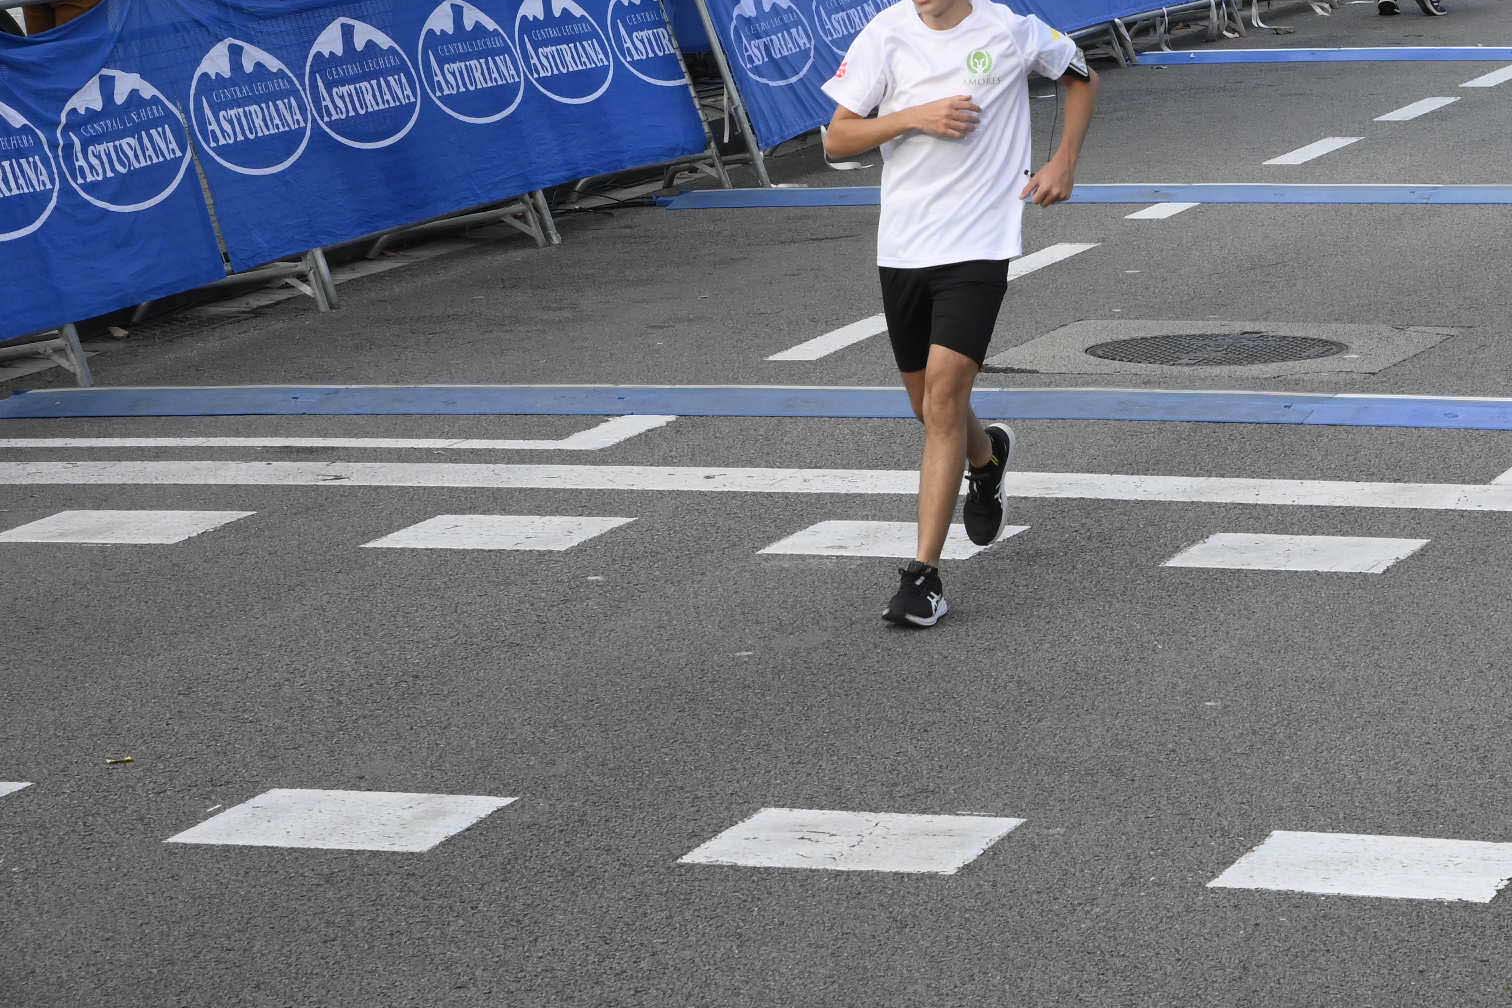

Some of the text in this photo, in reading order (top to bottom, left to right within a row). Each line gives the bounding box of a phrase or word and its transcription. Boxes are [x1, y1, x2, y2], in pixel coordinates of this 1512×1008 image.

[439, 36, 505, 56] CENTRAL LECHERA
[532, 23, 592, 41] CENTRAL LECHERA
[617, 19, 678, 61] ASTUR
[326, 54, 401, 80] CENTRAL LECHERA
[428, 49, 520, 97] ASTURIANA
[524, 33, 609, 79] ASTURIANA
[213, 78, 290, 103] CENTRAL LECHERA
[315, 72, 416, 123] ASTURIANA
[80, 118, 123, 137] CENTRAL
[202, 95, 306, 147] ASTURIANA
